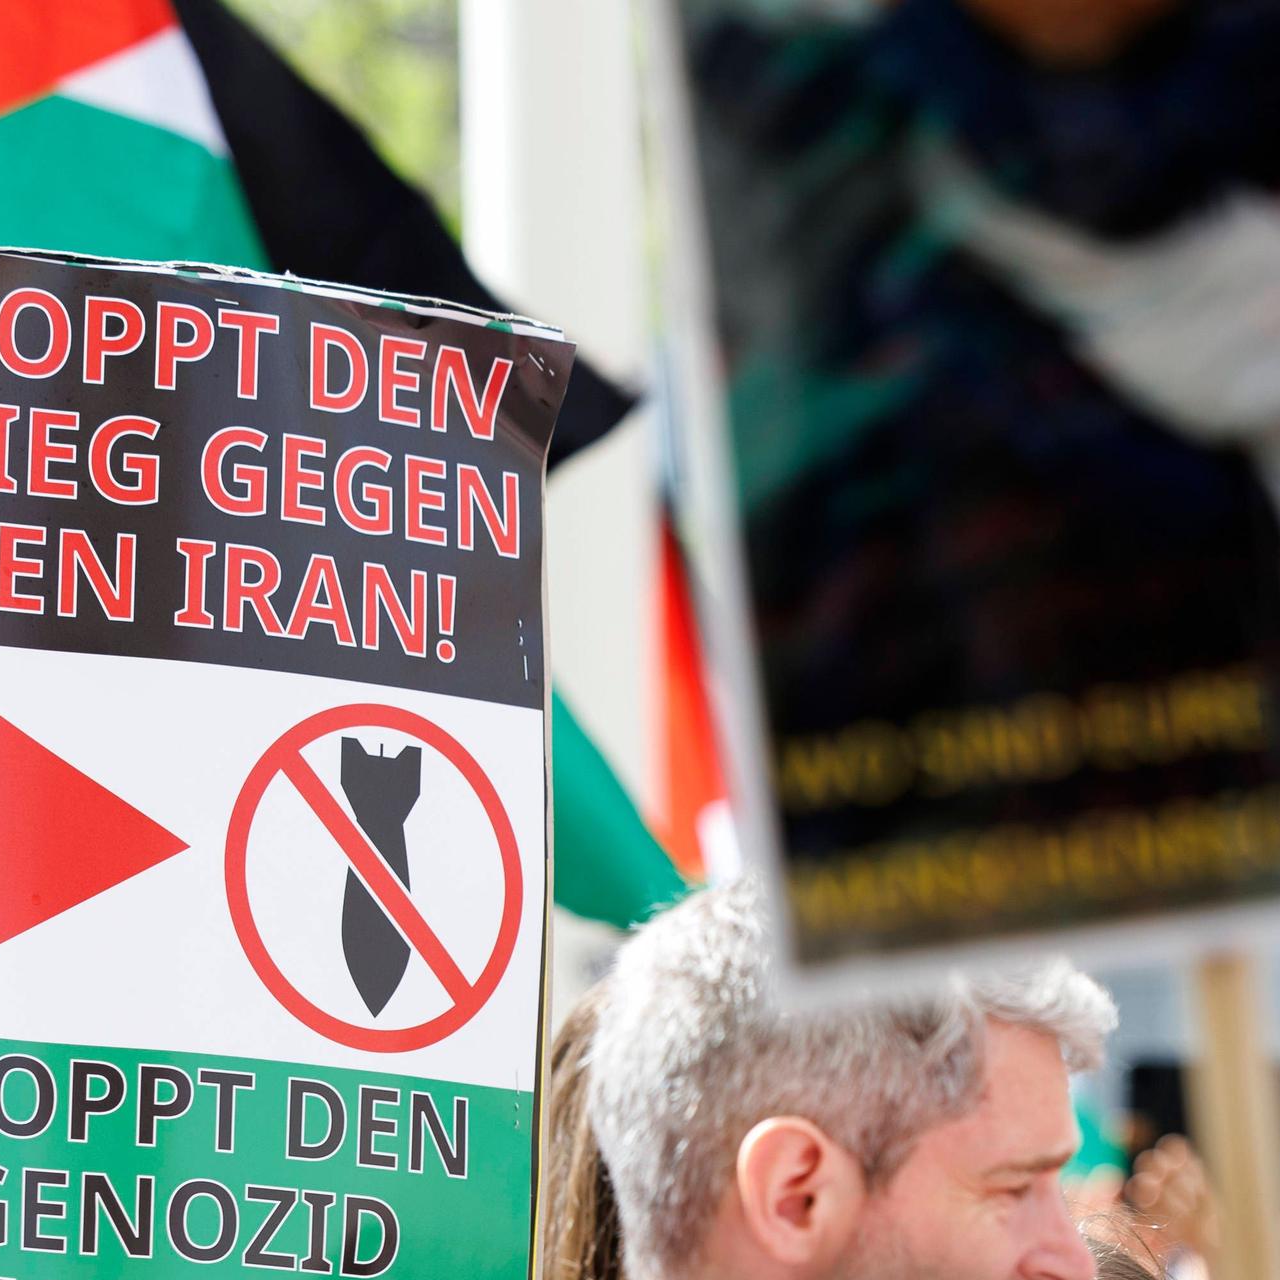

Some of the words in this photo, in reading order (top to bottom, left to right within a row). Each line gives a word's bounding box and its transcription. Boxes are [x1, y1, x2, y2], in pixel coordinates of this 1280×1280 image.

[308, 321, 514, 441] DEN
[200, 426, 521, 560] GEGEN
[174, 537, 458, 664] IRAN!
[285, 1077, 471, 1180] DEN
